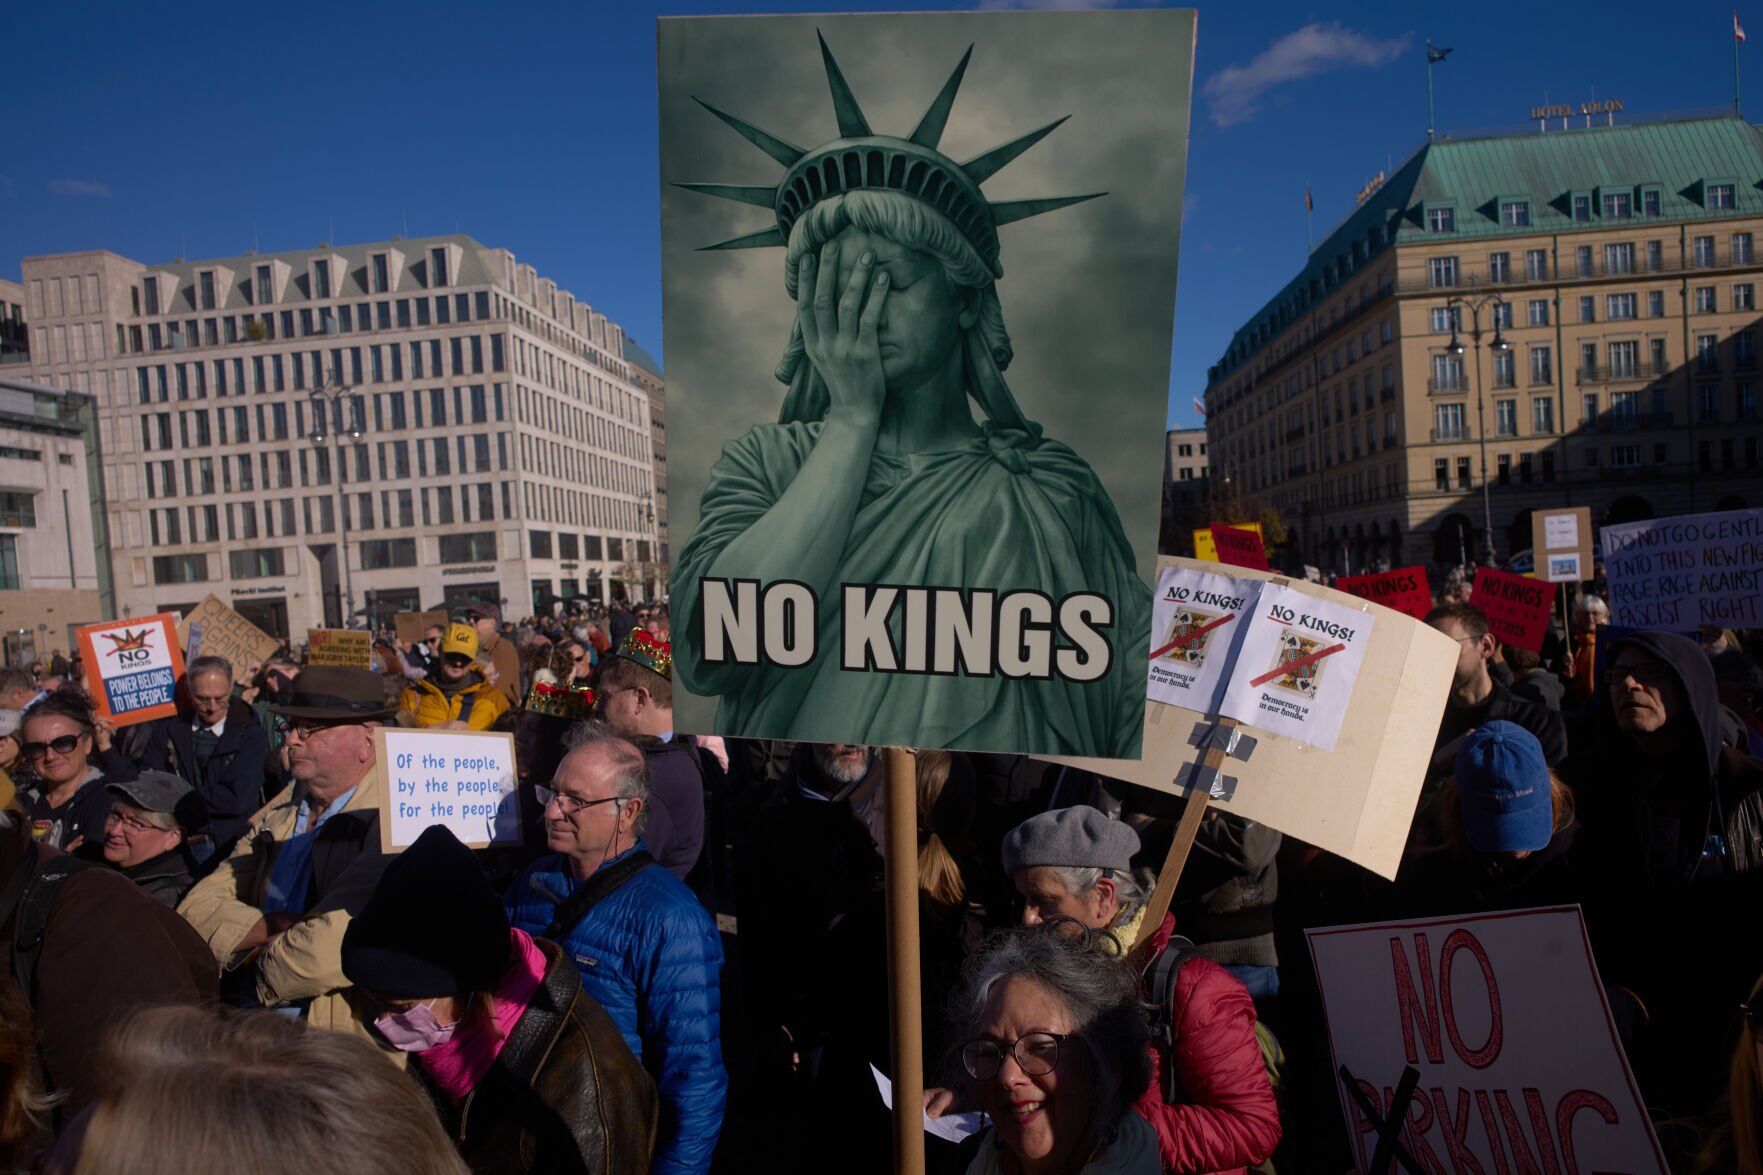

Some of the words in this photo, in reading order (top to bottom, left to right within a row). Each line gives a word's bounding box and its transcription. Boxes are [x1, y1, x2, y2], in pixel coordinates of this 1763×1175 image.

[1531, 104, 1575, 119] HOTEL
[1579, 98, 1624, 115] ADLON
[1610, 532, 1635, 552] DO
[1638, 525, 1671, 548] NOT
[1671, 524, 1699, 543] GO
[1613, 555, 1652, 578] INTO
[1654, 549, 1696, 571] THIS
[1703, 545, 1738, 567] NEW
[1348, 582, 1369, 598] NO
[1370, 575, 1417, 598] KINGS
[1481, 576, 1501, 596] NO
[1501, 581, 1545, 608] KINGS
[1699, 568, 1763, 593] AGAINST
[1167, 586, 1189, 600] NO
[1191, 590, 1245, 611] KINGS!
[1619, 599, 1683, 626] FASCIST
[1699, 594, 1761, 623] RIGHT
[203, 599, 265, 650] QUEERS
[700, 577, 818, 668] NO
[840, 582, 1115, 684] KINGS
[1270, 604, 1295, 622] NO
[1298, 613, 1355, 642] KINGS!
[119, 650, 149, 664] NO
[121, 660, 152, 670] KINGS
[109, 675, 138, 696] POWER
[137, 669, 173, 690] BELONGS
[1152, 666, 1188, 682] Democracy
[1157, 676, 1169, 684] our
[1169, 677, 1191, 690] hands.
[113, 695, 125, 712] TO
[123, 692, 141, 710] THE
[1261, 693, 1301, 714] Democracy
[1266, 705, 1280, 714] our
[1280, 707, 1305, 722] hands.
[397, 753, 413, 769] Of
[422, 753, 446, 769] the
[454, 756, 500, 773] people,
[398, 778, 416, 797] by
[425, 777, 448, 792] the
[457, 778, 503, 797] people,
[399, 802, 421, 818] for
[430, 801, 454, 817] the
[462, 801, 509, 820] people!
[1389, 928, 1503, 1070] NO
[1350, 1078, 1637, 1175] PRKING
